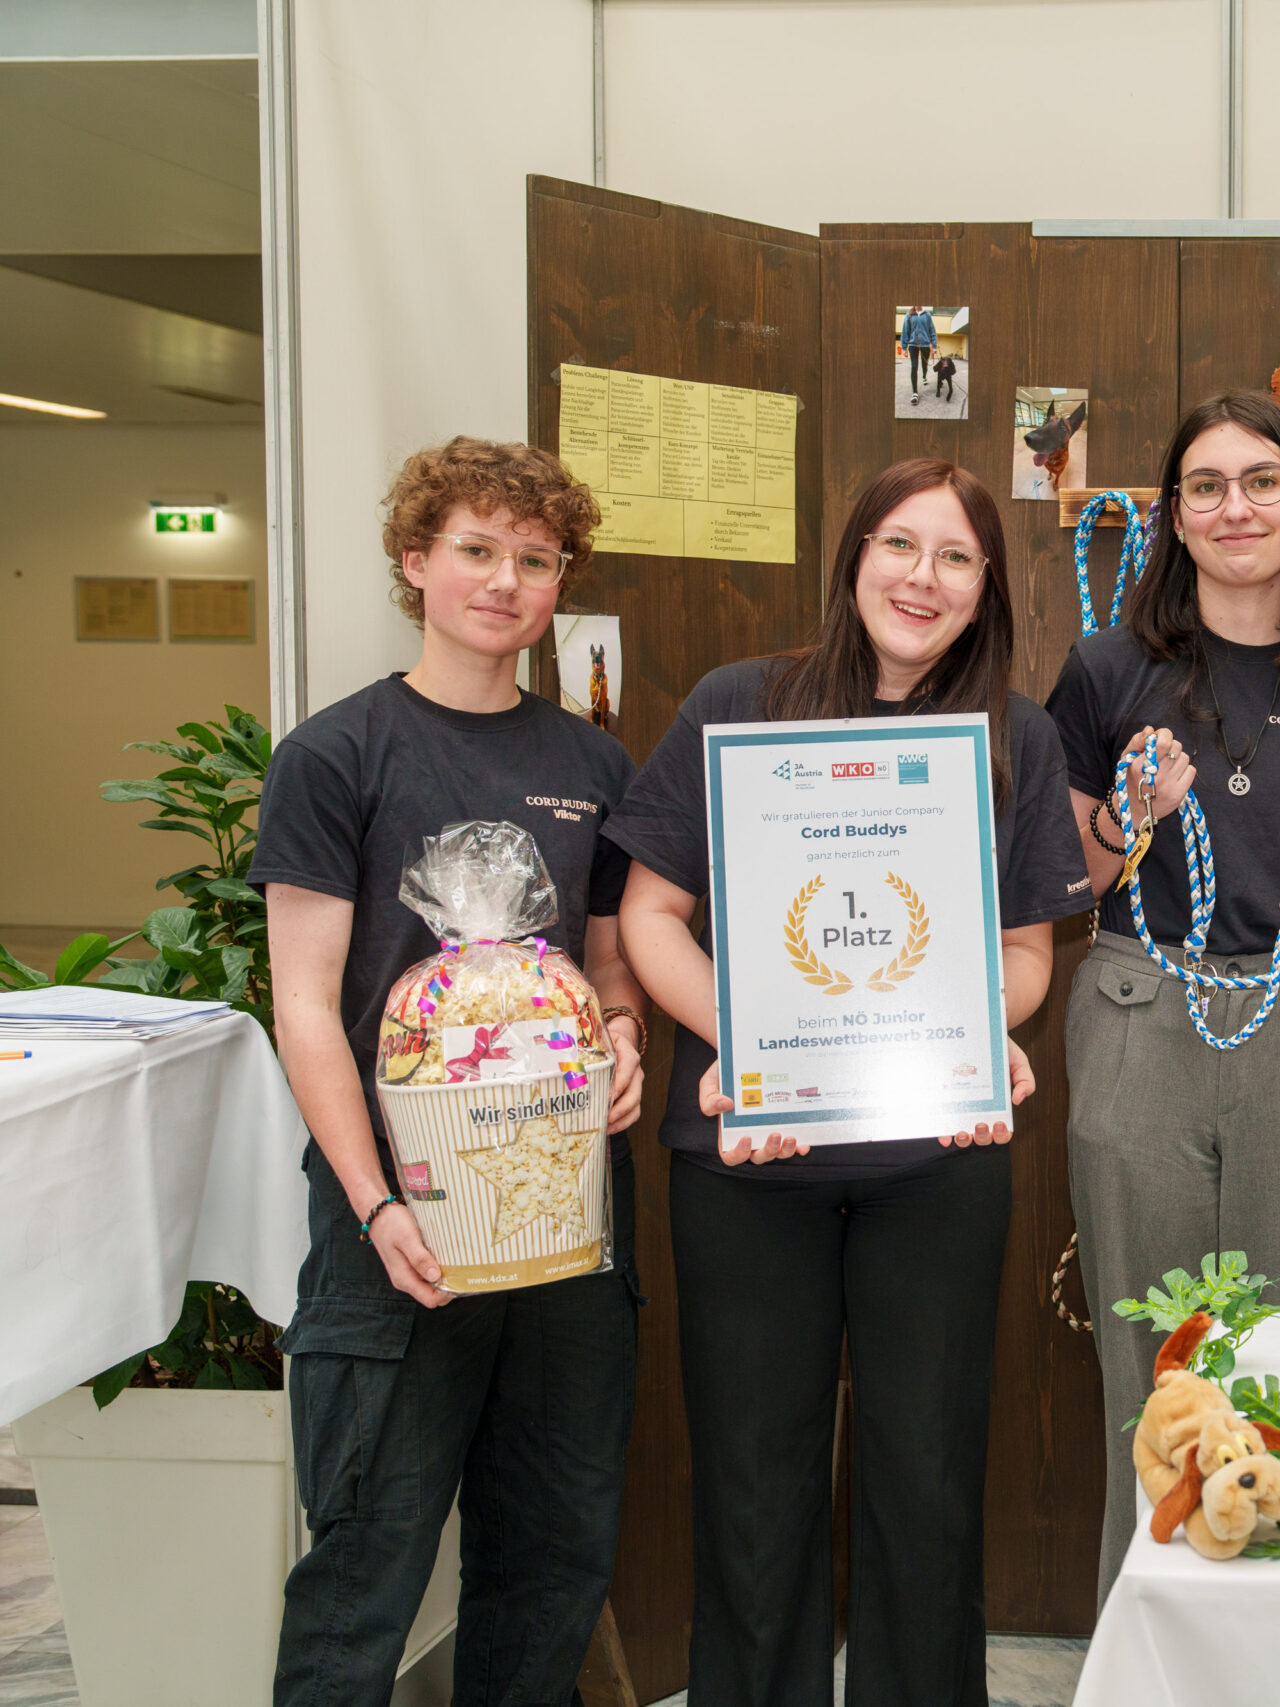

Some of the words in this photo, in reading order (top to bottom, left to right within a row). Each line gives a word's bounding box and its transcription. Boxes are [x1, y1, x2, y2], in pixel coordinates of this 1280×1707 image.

[612, 499, 632, 508] Kosten
[726, 508, 762, 518] Ertragsquellen
[832, 763, 874, 777] WKO
[526, 796, 560, 807] CORD
[553, 809, 581, 822] Viktor
[761, 812, 780, 822] Wir
[782, 809, 839, 825] gratulieren
[841, 808, 858, 818] der
[860, 807, 893, 817] Junior
[895, 805, 945, 818] Company
[801, 825, 840, 839] Cord
[845, 822, 908, 839] Buddys
[806, 851, 831, 862] ganz
[834, 849, 875, 860] herzlich
[877, 848, 900, 857] zum
[842, 891, 867, 919] 1.
[822, 926, 893, 948] Platz
[797, 1016, 838, 1030] beim
[842, 1011, 868, 1027] NÖ
[872, 1010, 926, 1025] Junior
[758, 1029, 921, 1050] Landeswettbewerb
[926, 1026, 966, 1041] 2026
[469, 1106, 501, 1126] Wir
[506, 1098, 544, 1120] sind
[548, 1090, 591, 1113] KINO!
[466, 1273, 519, 1285] www.4dx.at
